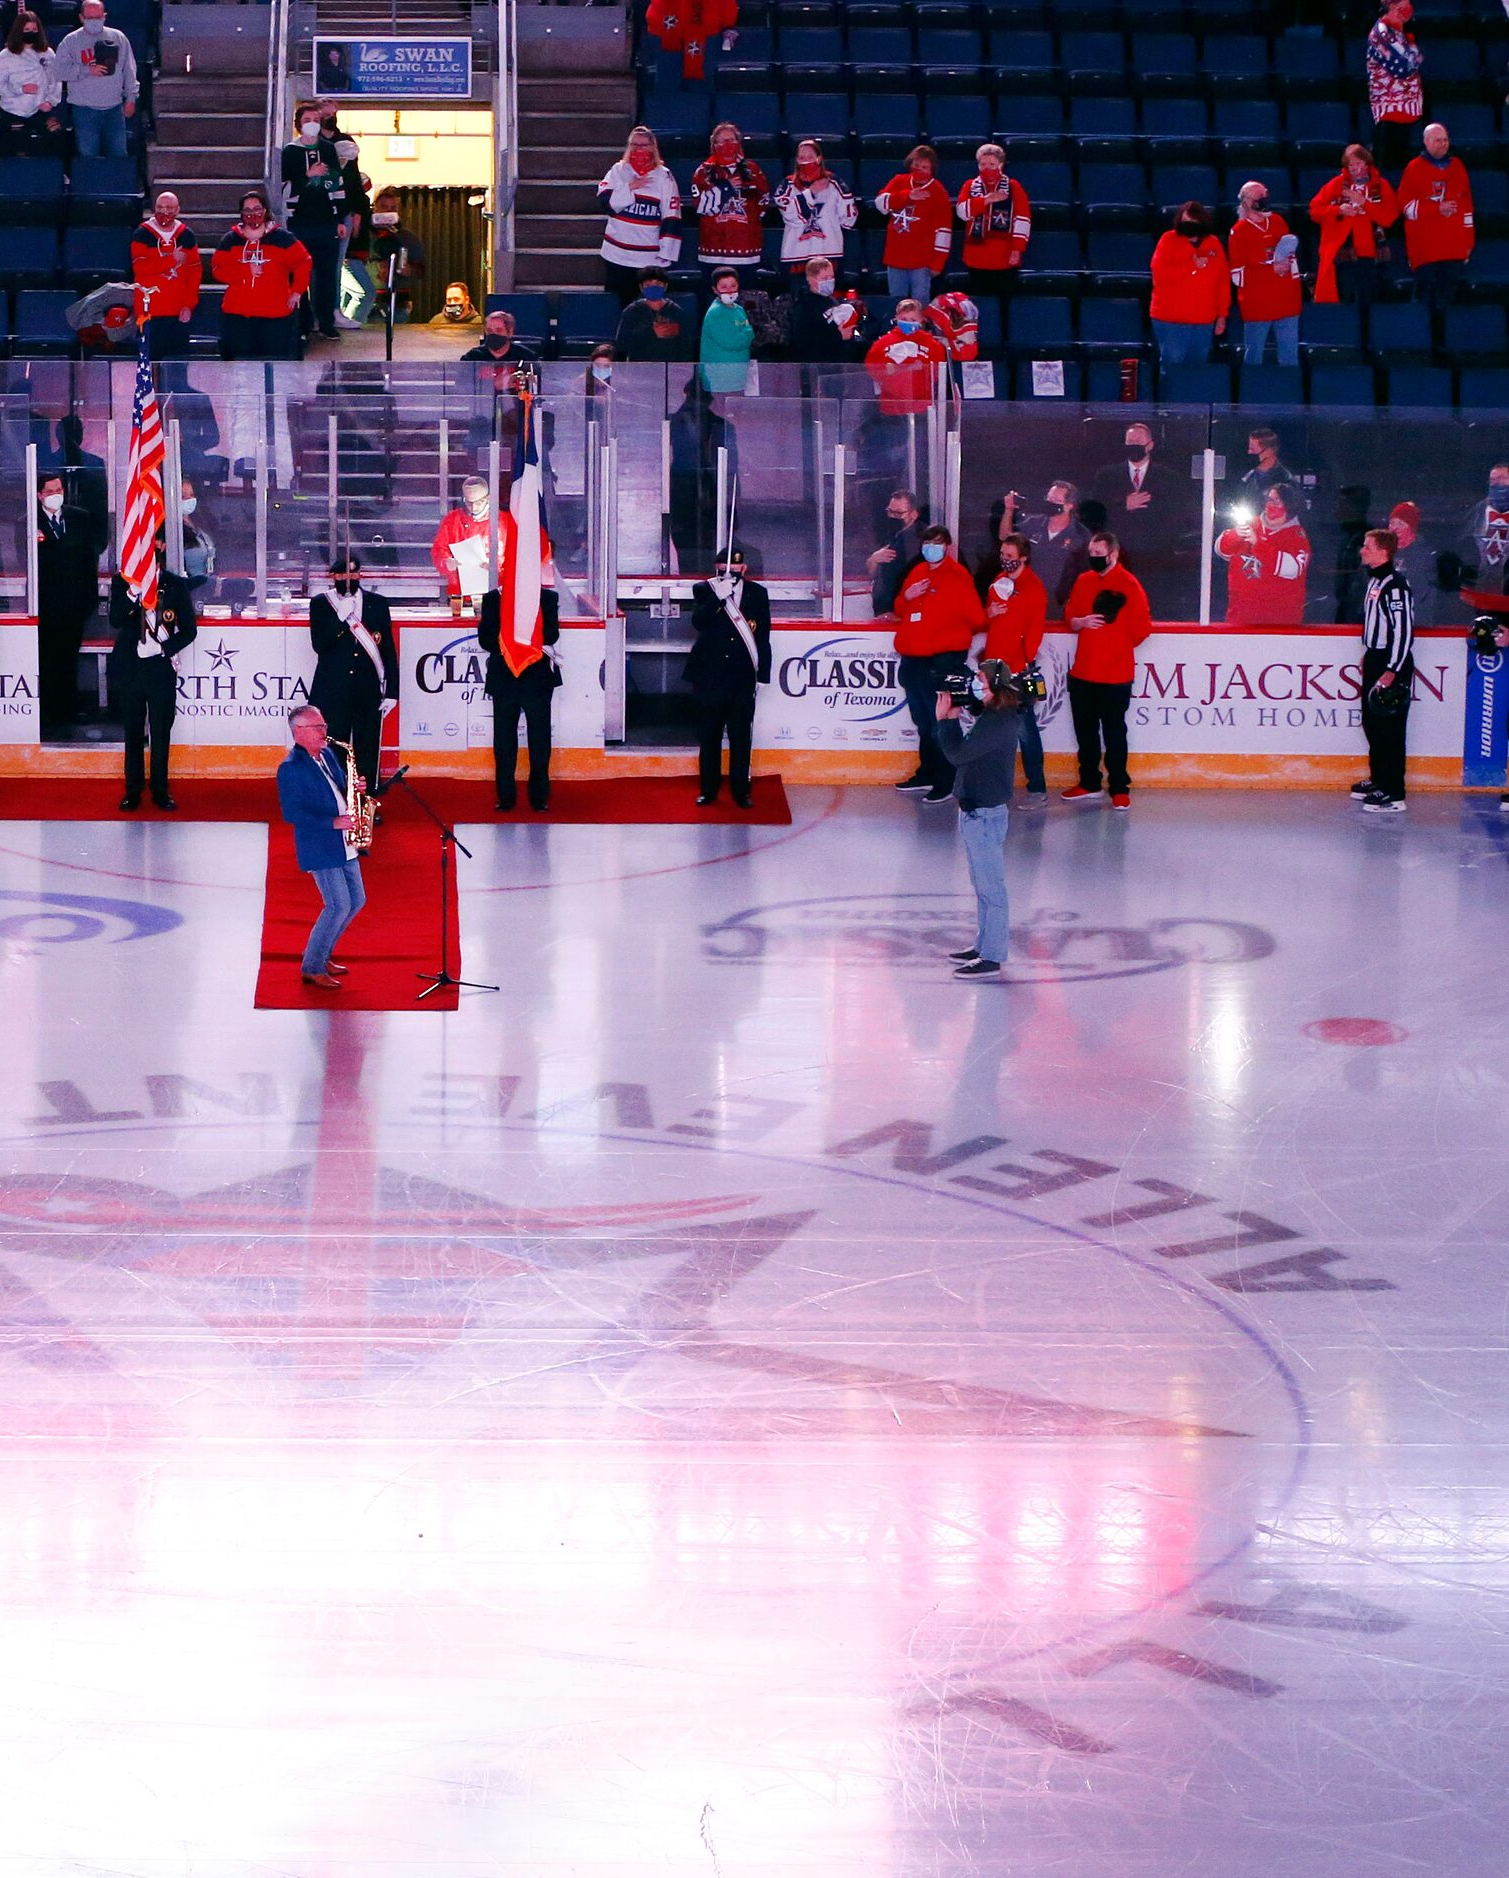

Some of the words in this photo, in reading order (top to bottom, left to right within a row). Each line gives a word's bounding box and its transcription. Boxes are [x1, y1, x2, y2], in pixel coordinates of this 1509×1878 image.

[395, 47, 454, 62] SWAN
[359, 62, 423, 73] ROOFING,
[428, 62, 463, 73] L.L.C.
[252, 672, 310, 700] STA
[779, 657, 903, 698] CLASSI
[1200, 663, 1449, 706] JACKSN
[461, 687, 478, 704] of
[824, 692, 841, 709] of
[844, 692, 897, 706] Texoma
[1135, 706, 1237, 727] STOM
[1257, 708, 1362, 728] HOME
[1480, 676, 1494, 758] WARRIOR
[24, 1073, 809, 1142] EVENT
[826, 1118, 1397, 1294] ALLEN
